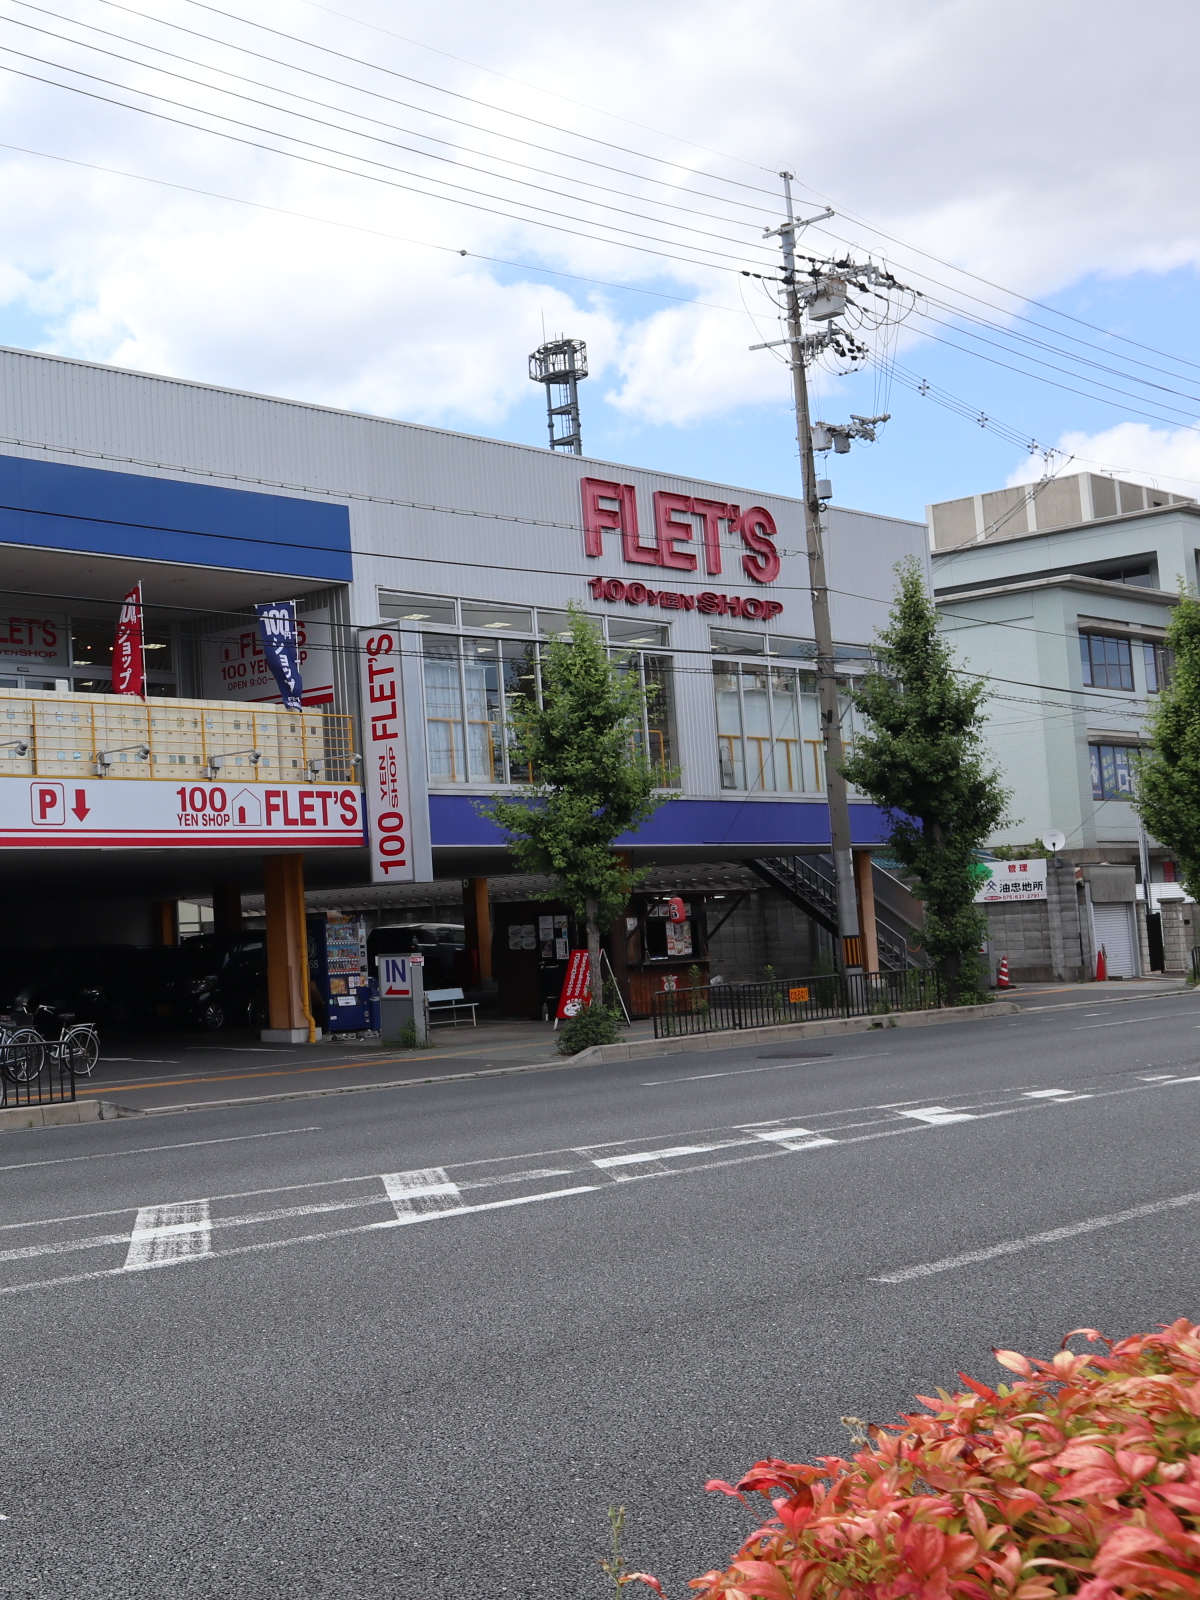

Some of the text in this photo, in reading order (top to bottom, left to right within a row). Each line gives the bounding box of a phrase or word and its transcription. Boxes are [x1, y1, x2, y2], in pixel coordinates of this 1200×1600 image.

[580, 476, 781, 584] FLET'S
[587, 576, 784, 620] 100 YEN SHOP
[220, 663, 247, 681] 100
[227, 680, 248, 691] OPEN
[366, 633, 399, 742] FLET'S
[379, 755, 387, 802] YEN
[389, 746, 399, 809] SHOP
[38, 788, 58, 820] P
[175, 786, 228, 813] 100
[264, 789, 358, 827] FLET'S
[177, 813, 231, 827] YEN SHOP
[377, 811, 406, 875] 100
[999, 880, 1044, 893] 油忠地所
[385, 959, 407, 983] IN
